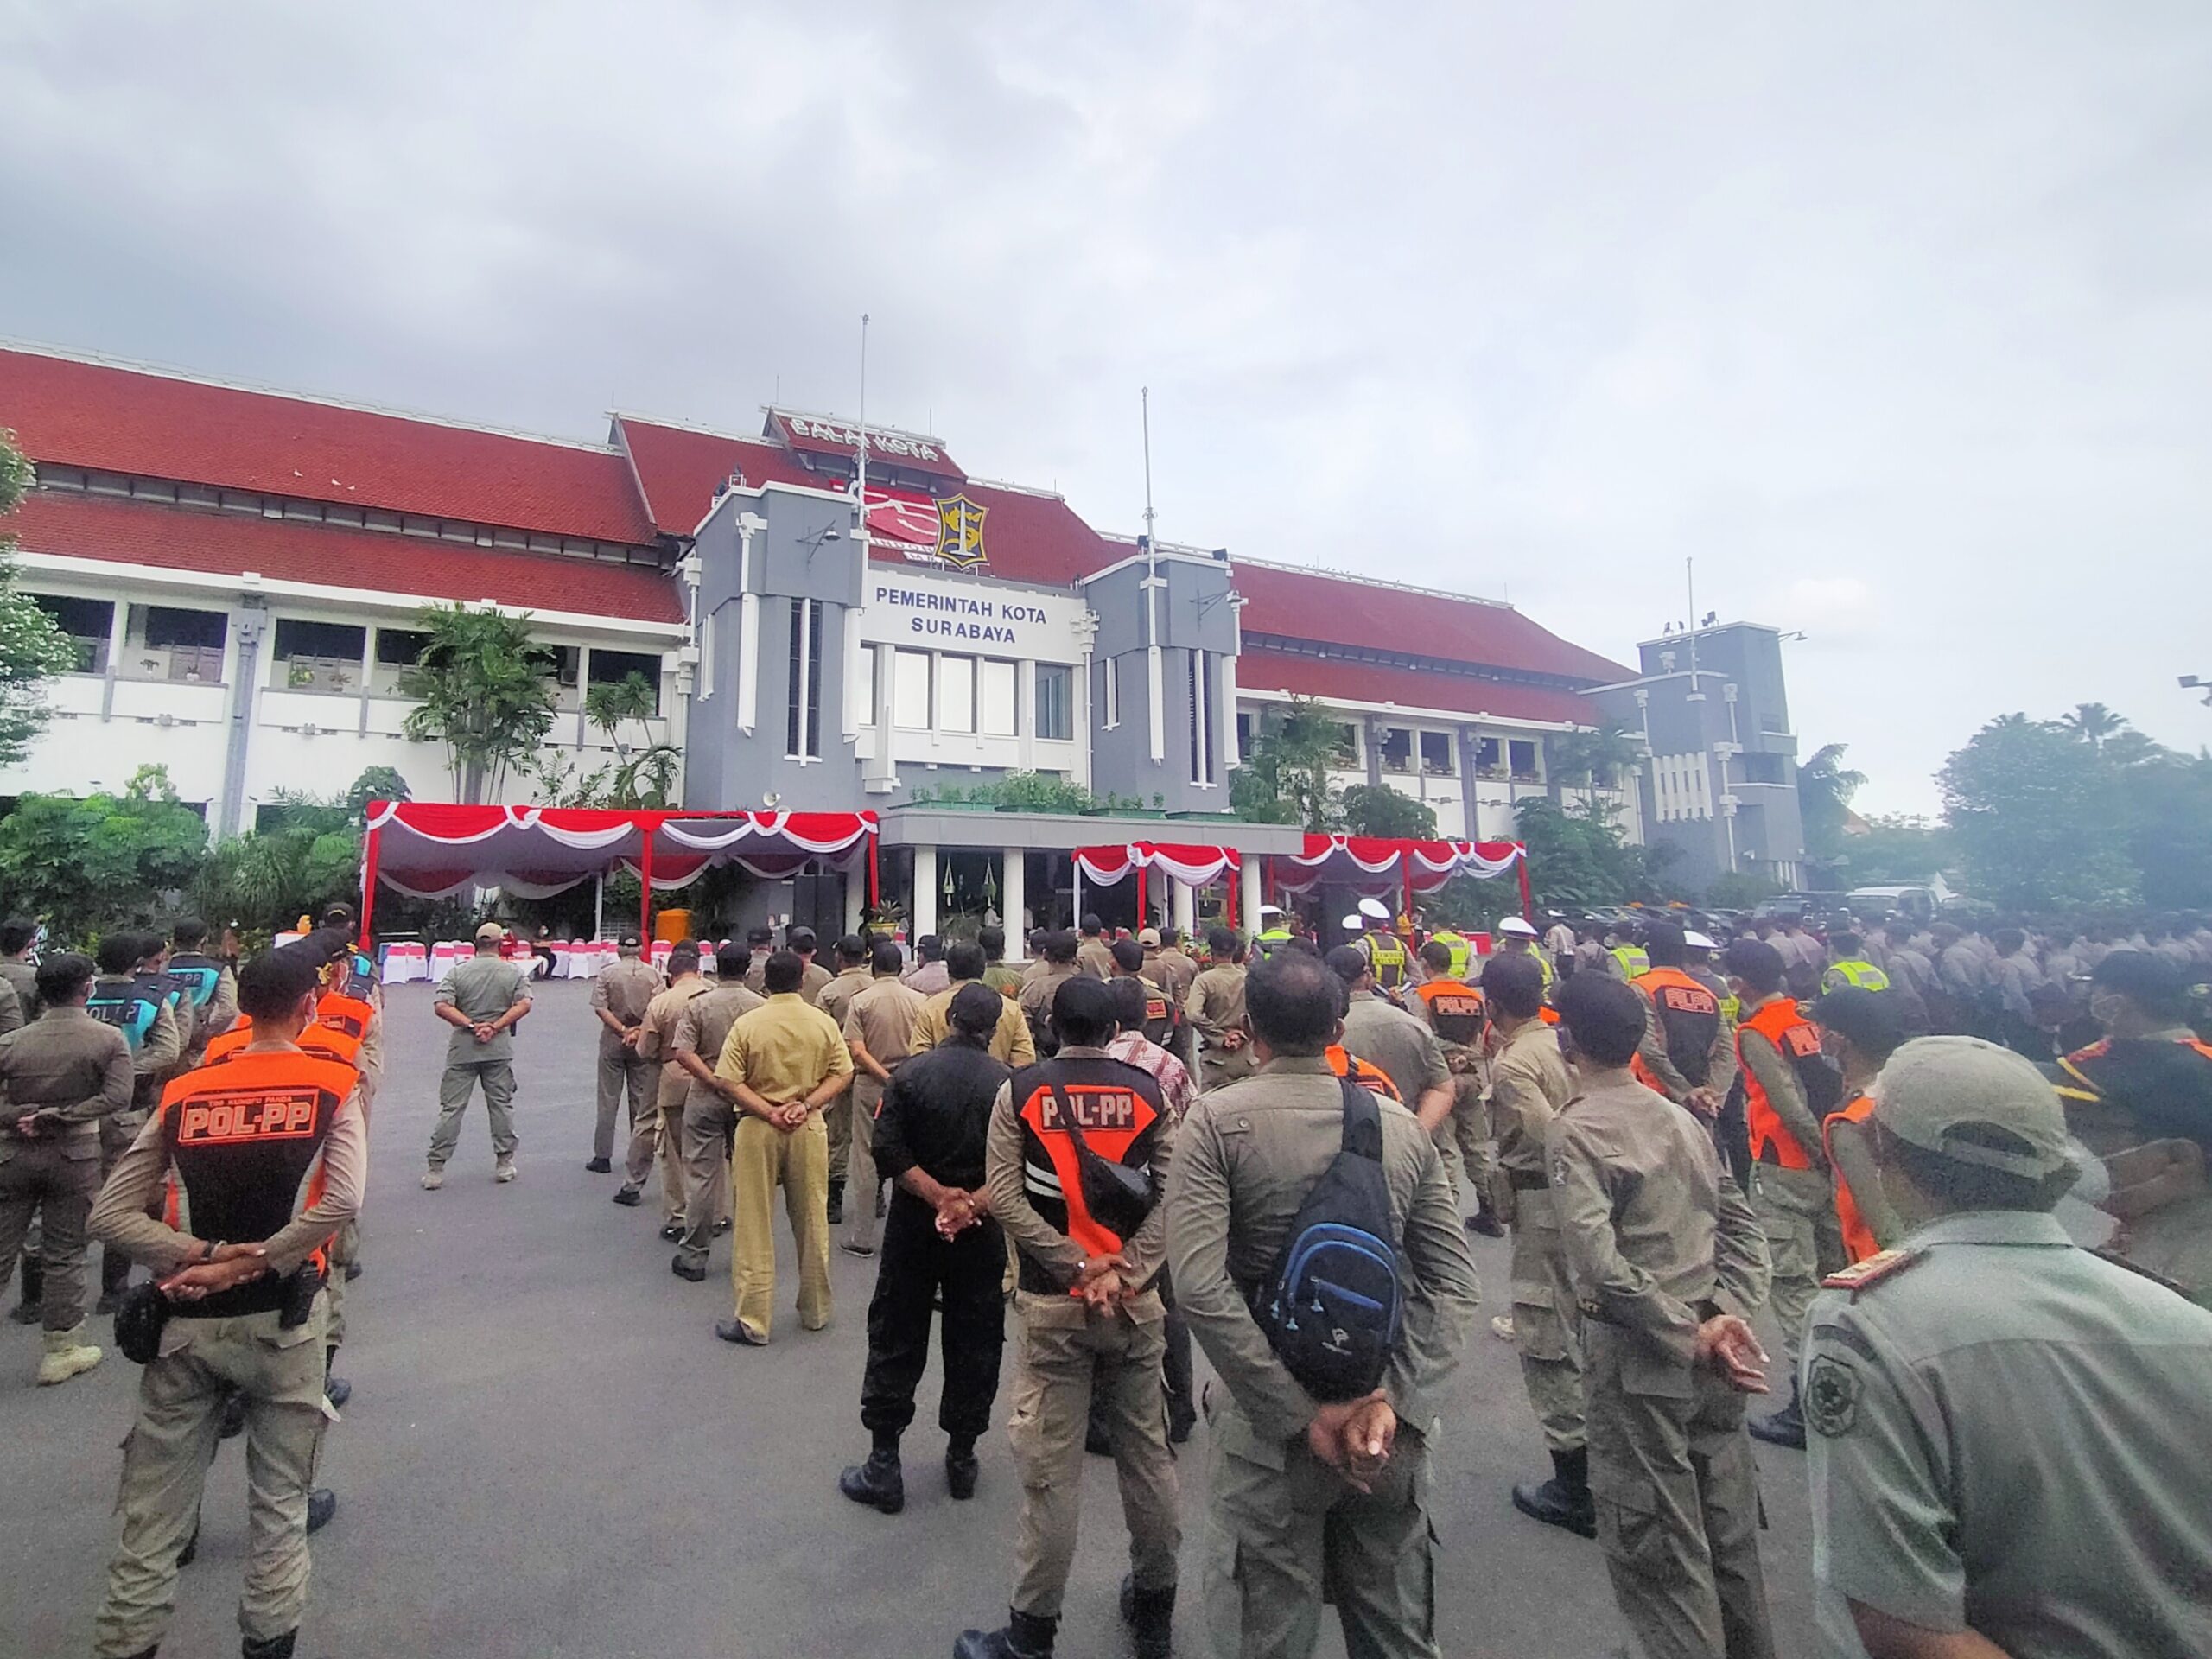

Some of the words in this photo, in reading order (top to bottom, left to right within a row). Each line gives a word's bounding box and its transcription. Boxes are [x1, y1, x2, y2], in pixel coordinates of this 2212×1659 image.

[874, 435, 939, 461] KOTA
[875, 587, 993, 617] PEMERINTAH
[1002, 604, 1046, 624] KOTA
[911, 617, 1015, 643] SURABAYA
[88, 1006, 111, 1021] OL
[183, 1102, 312, 1139] POL-PP
